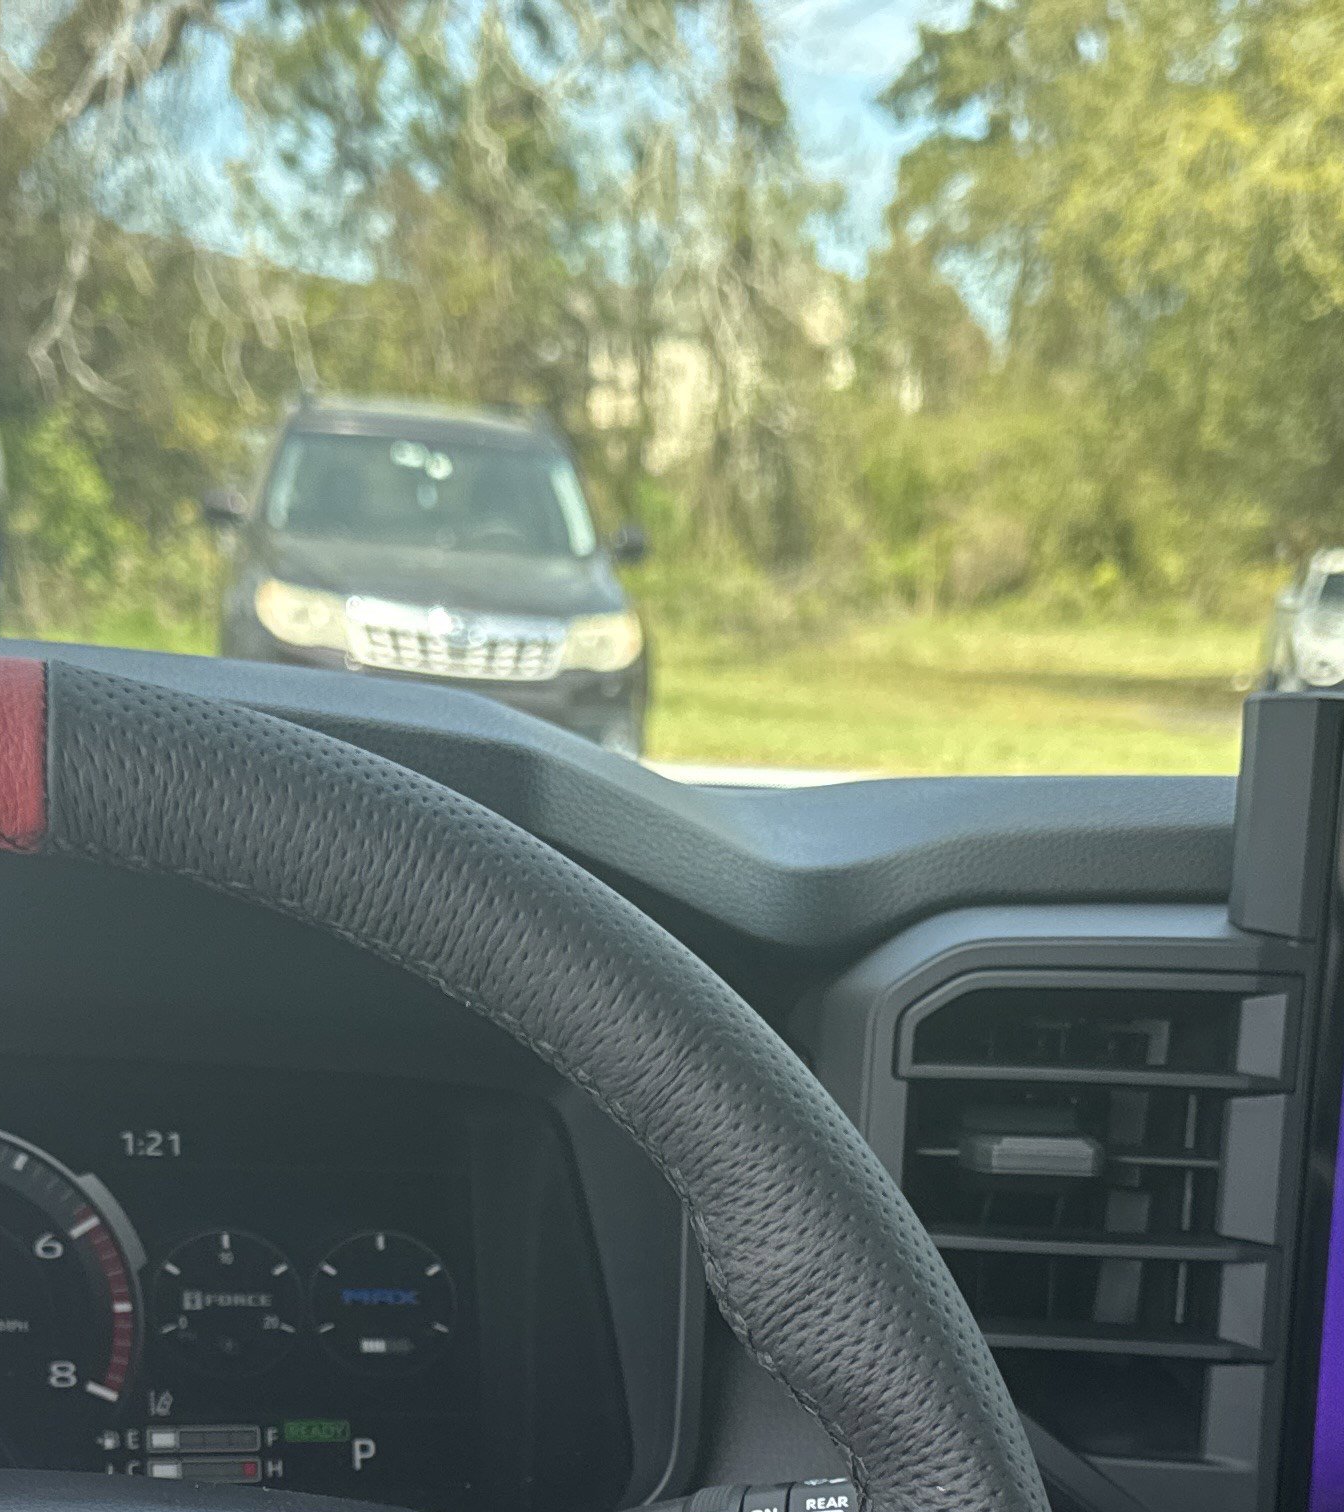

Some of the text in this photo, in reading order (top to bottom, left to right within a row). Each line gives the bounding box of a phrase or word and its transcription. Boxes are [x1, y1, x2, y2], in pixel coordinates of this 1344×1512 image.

[119, 1130, 182, 1157] 1:21
[34, 1233, 65, 1260] 6
[49, 1360, 77, 1389] 8
[127, 1429, 141, 1451] E
[266, 1426, 280, 1448] F
[352, 1437, 377, 1471] P
[266, 1459, 284, 1478] H
[805, 1495, 849, 1511] REAR
